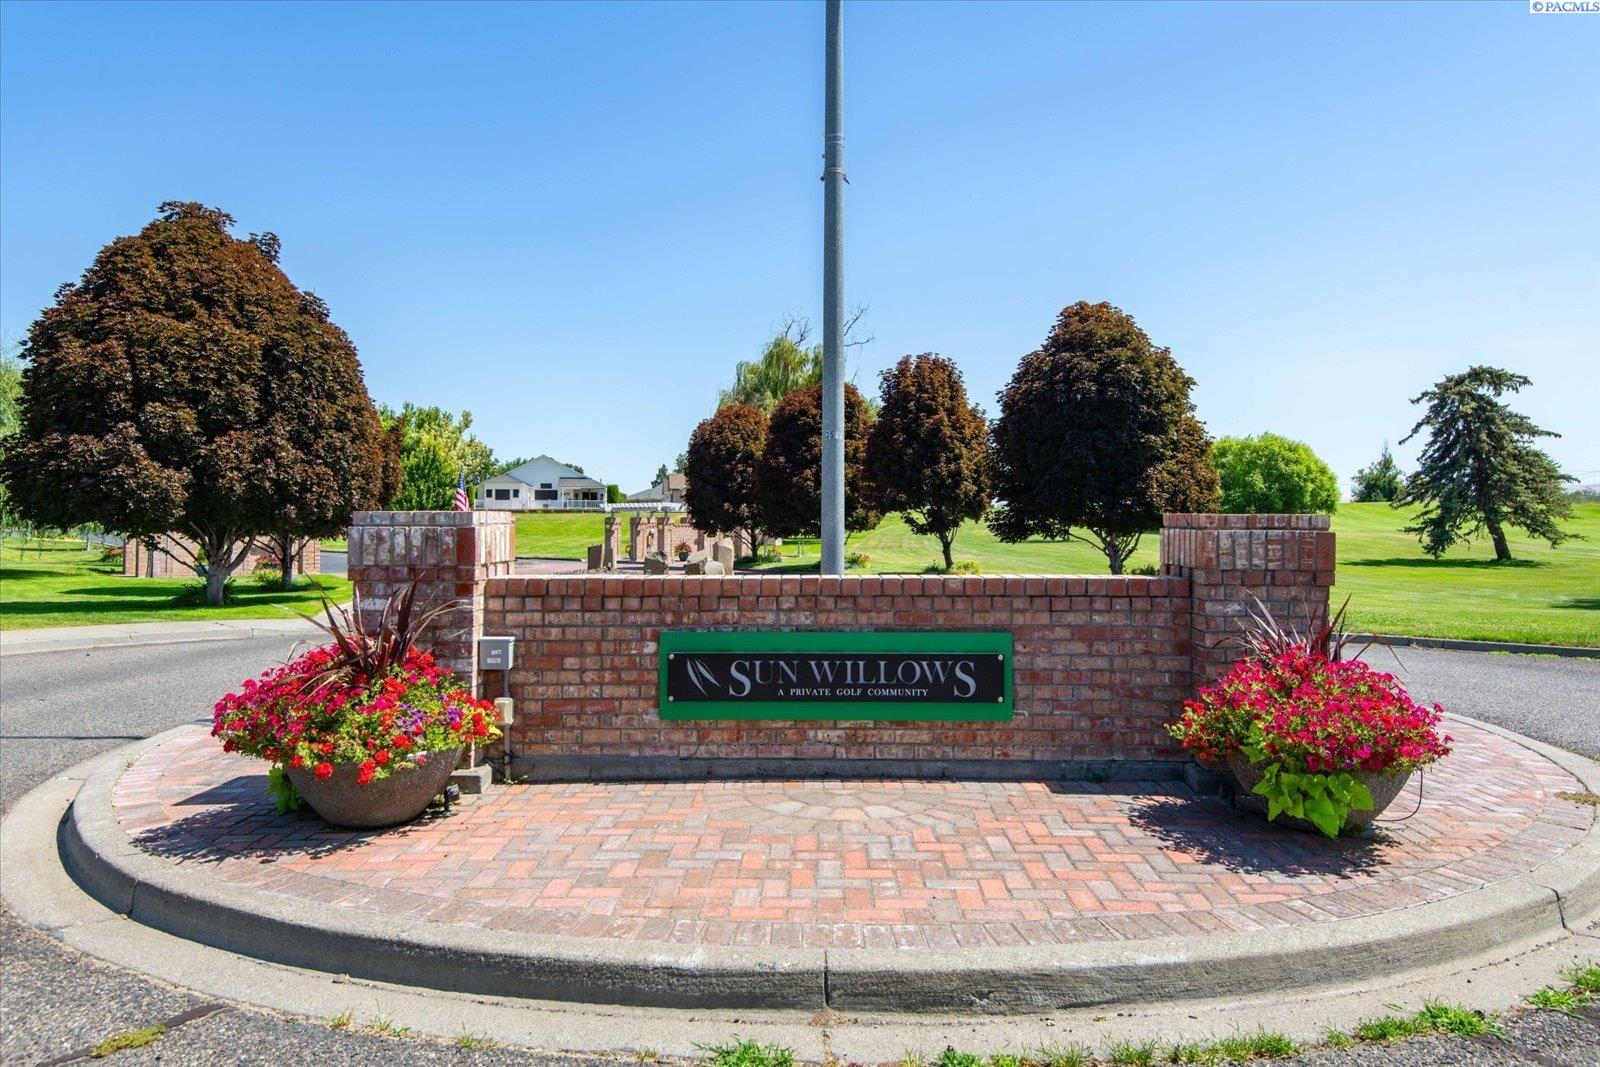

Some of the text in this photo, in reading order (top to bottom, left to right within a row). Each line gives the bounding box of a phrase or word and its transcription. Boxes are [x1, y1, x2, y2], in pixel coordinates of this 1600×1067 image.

[728, 660, 977, 697] SUN WILLOWS
[790, 688, 832, 696] PRIVATE
[836, 688, 863, 696] GOLF
[867, 688, 929, 696] COMMUNITY
